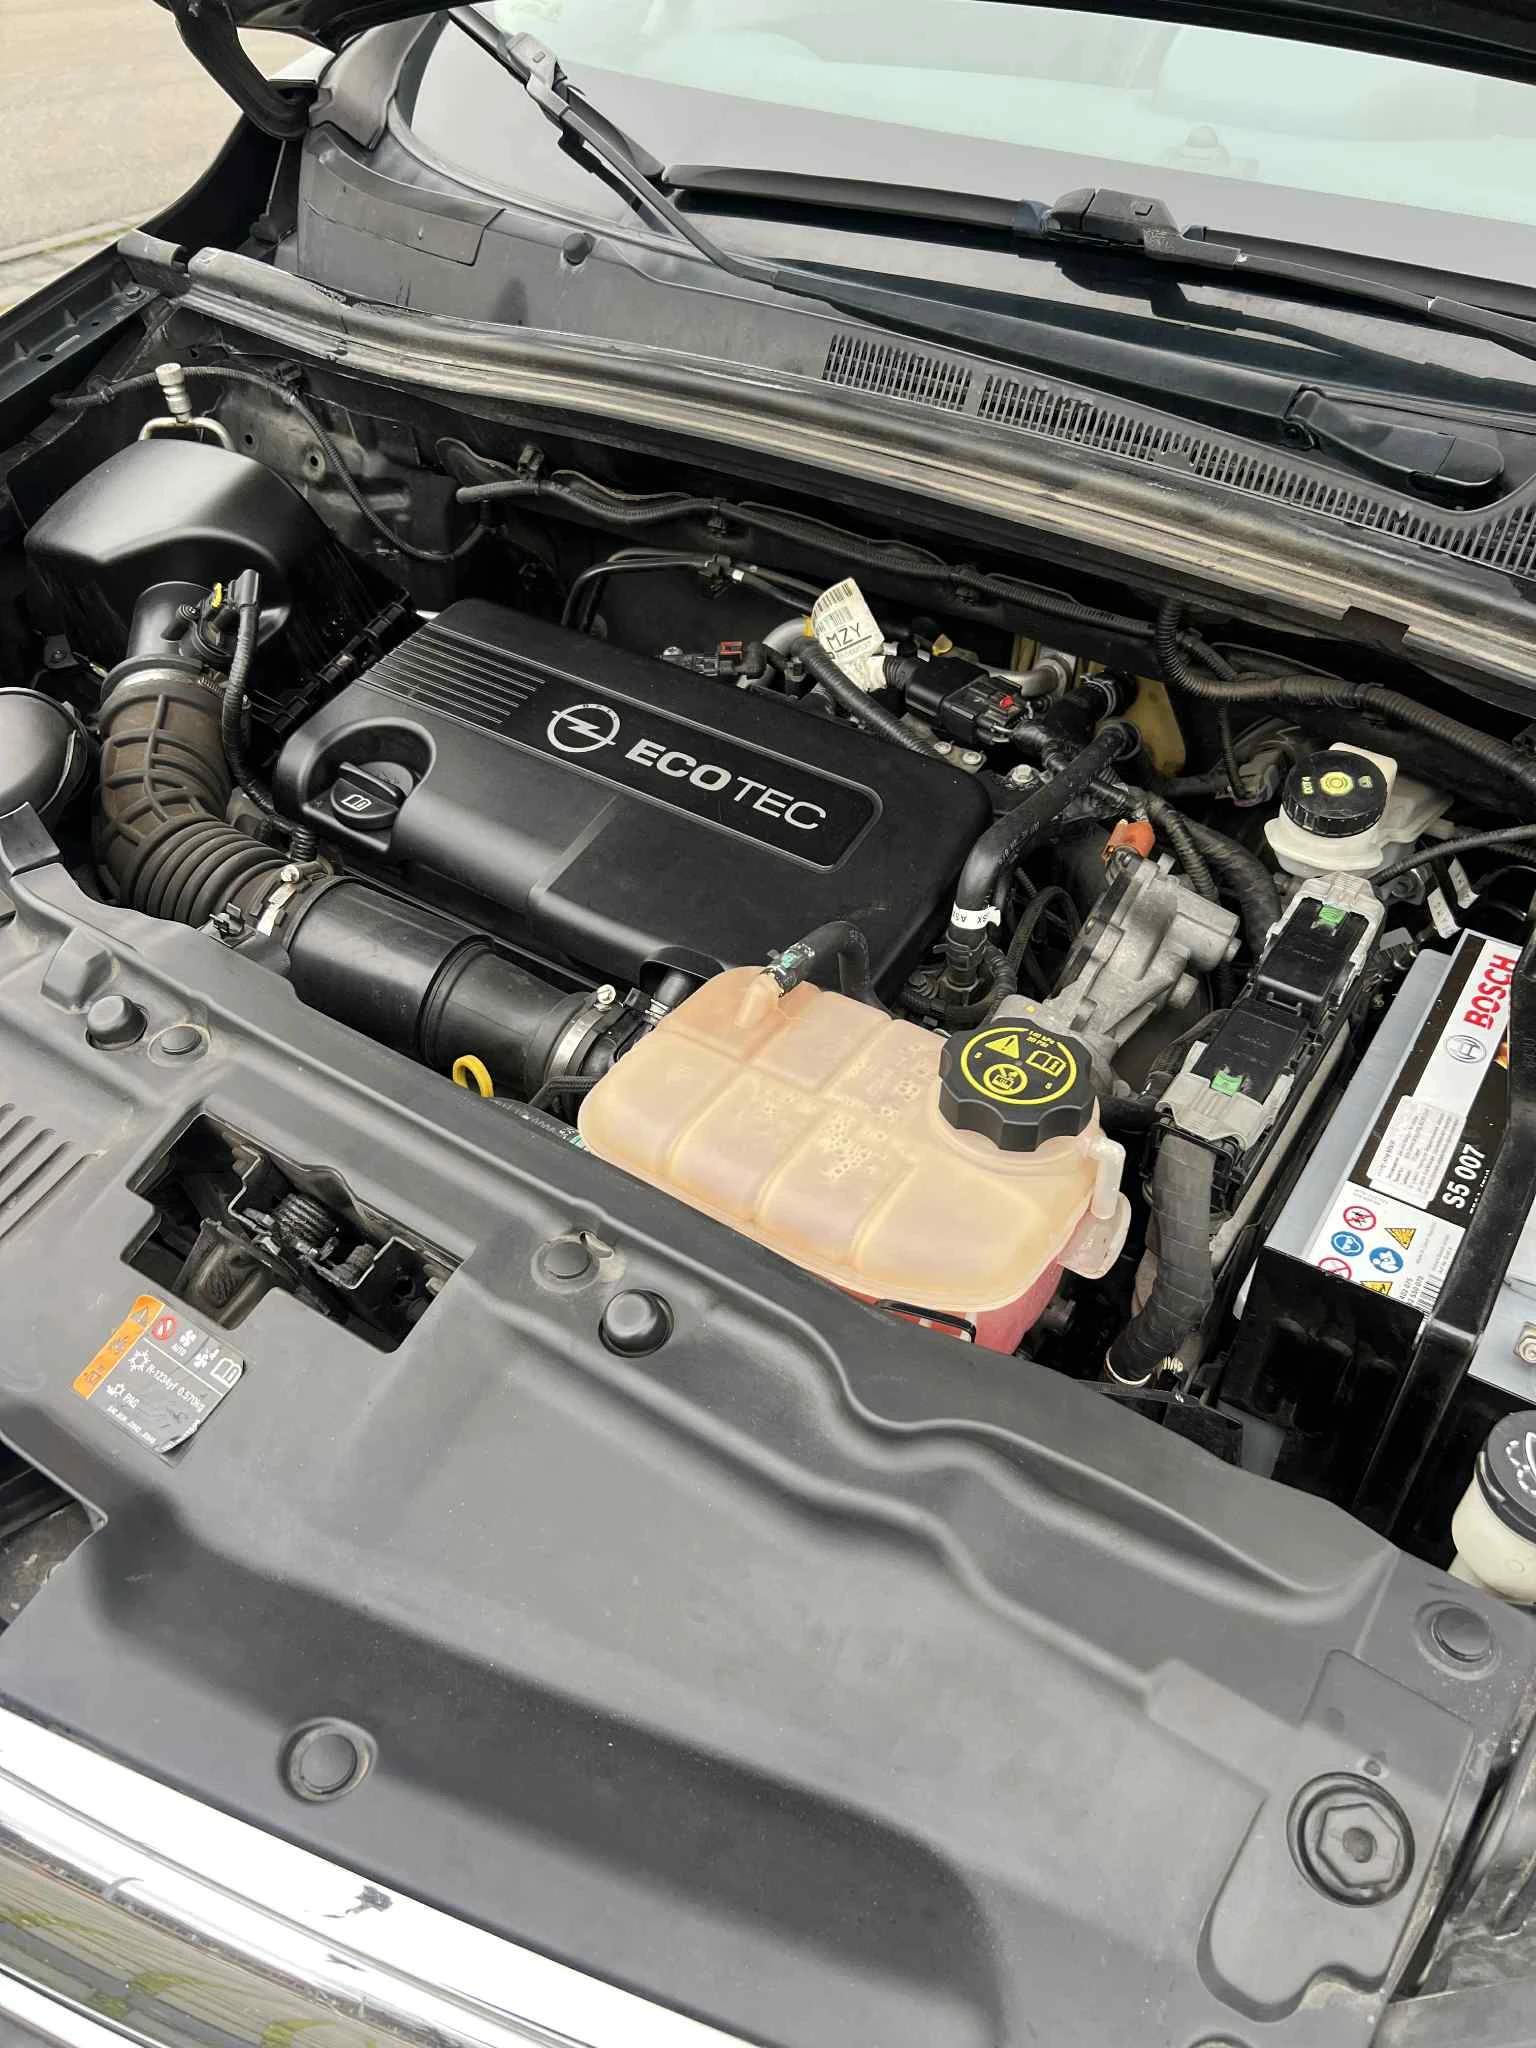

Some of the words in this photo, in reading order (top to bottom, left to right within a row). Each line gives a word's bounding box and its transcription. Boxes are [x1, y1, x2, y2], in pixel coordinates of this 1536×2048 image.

[825, 622, 862, 650] MZY
[624, 738, 828, 830] ECOTEC
[1463, 953, 1517, 1030] BOSCH
[1454, 1143, 1486, 1181] 007
[1441, 1180, 1471, 1209] S5
